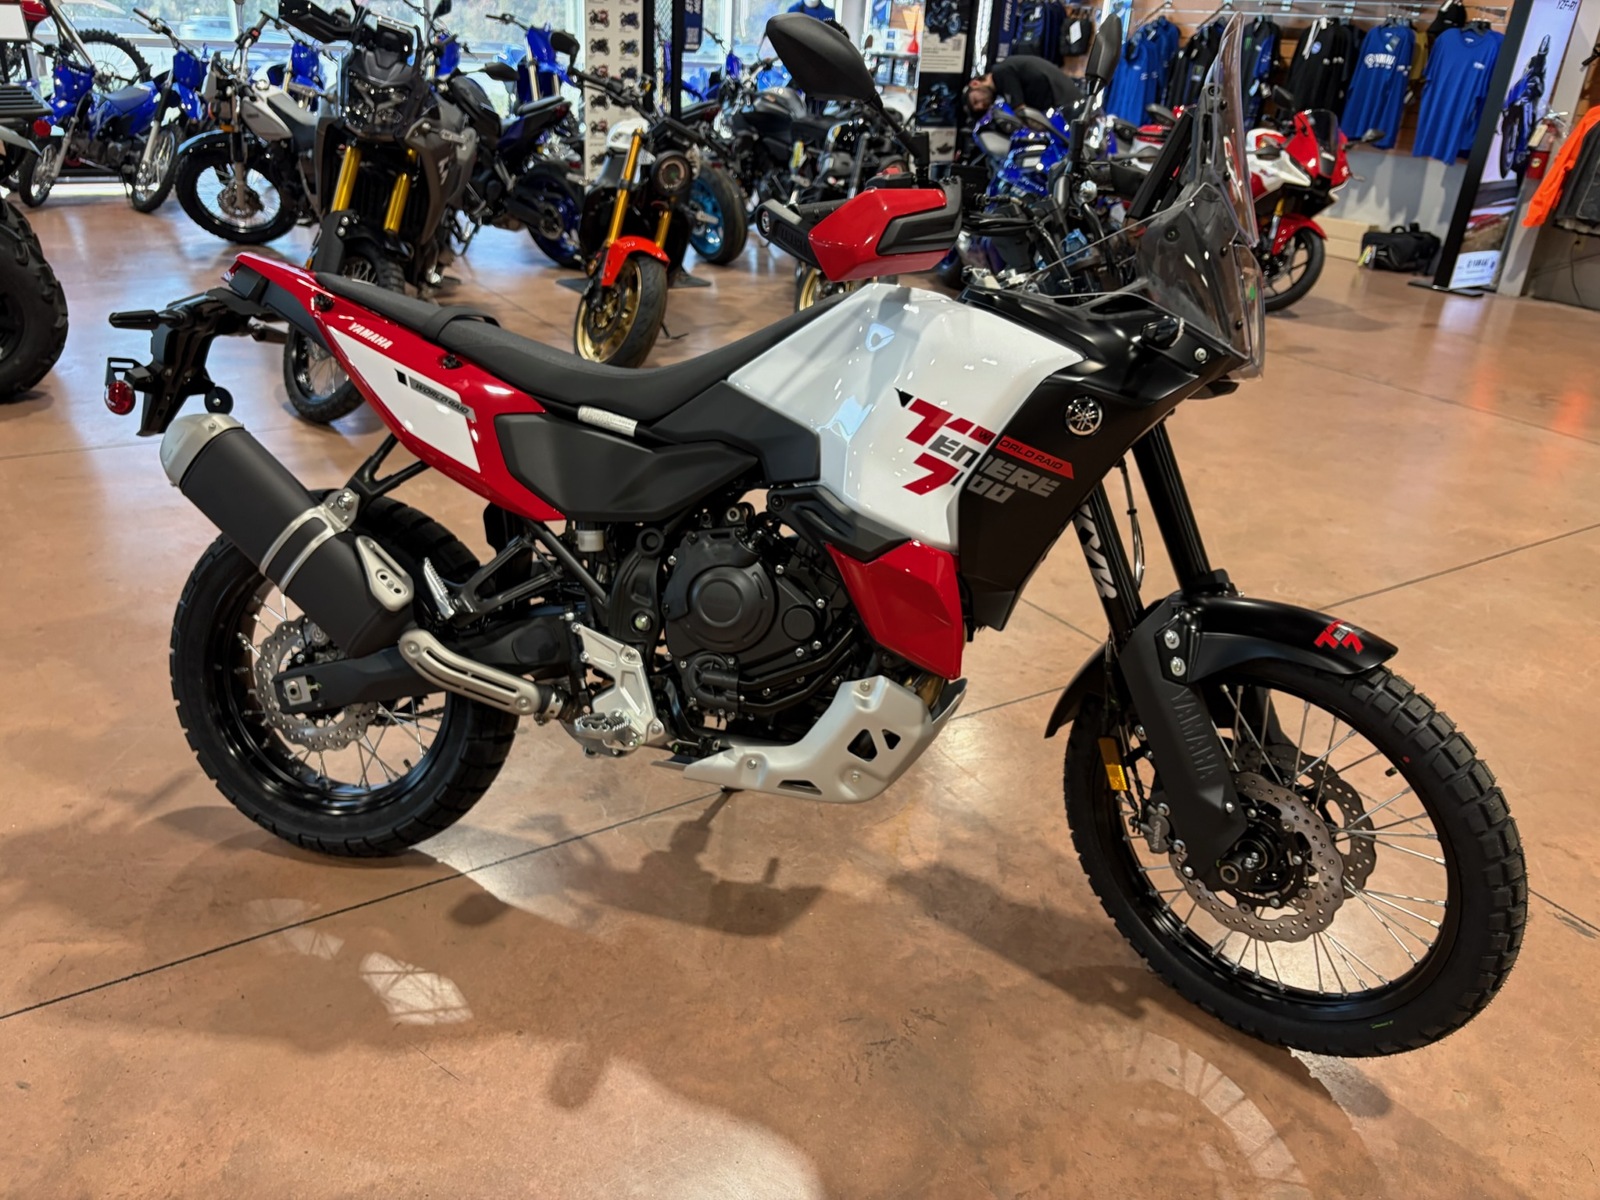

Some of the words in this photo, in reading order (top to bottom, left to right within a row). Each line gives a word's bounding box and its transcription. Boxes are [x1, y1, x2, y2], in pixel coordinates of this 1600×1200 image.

[348, 322, 394, 350] YAMAHA
[415, 383, 448, 403] WORLD
[447, 399, 470, 415] RAID
[978, 430, 1035, 458] WORLD
[1034, 454, 1065, 470] RAID
[1170, 687, 1219, 780] YAMAHA
